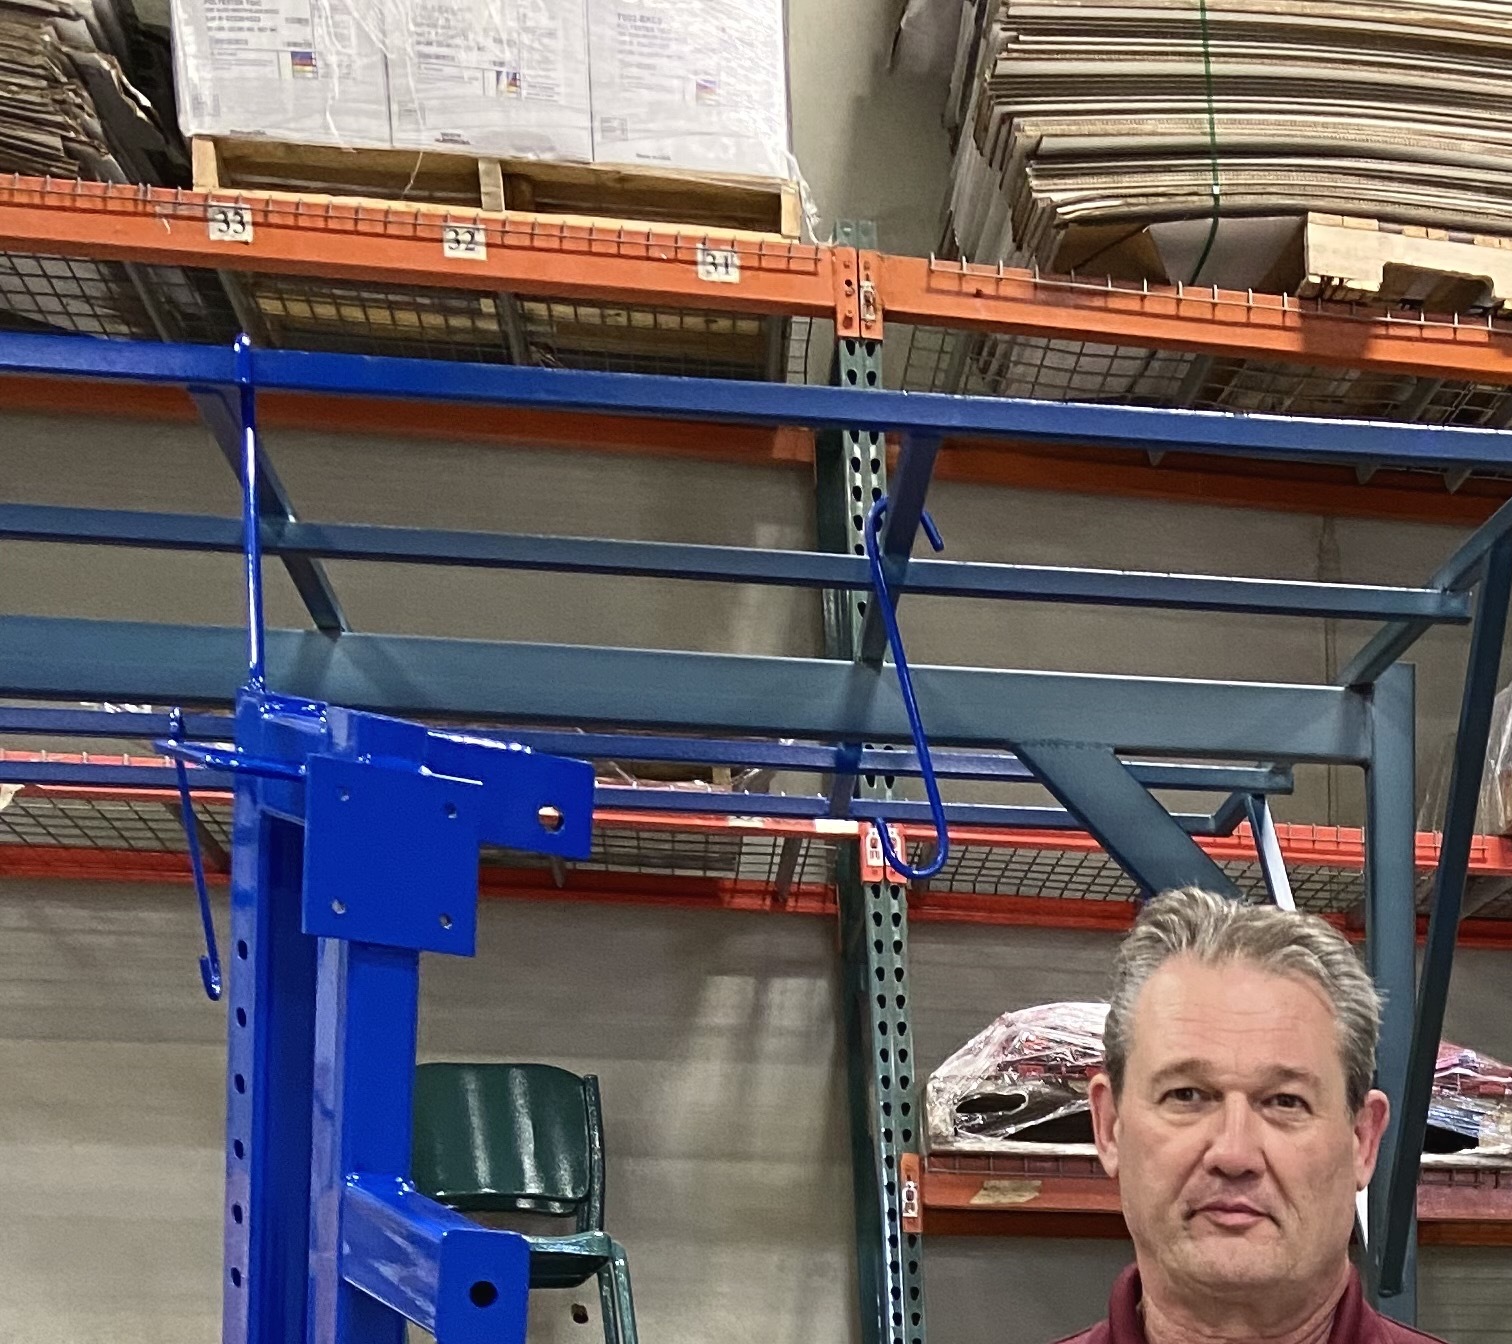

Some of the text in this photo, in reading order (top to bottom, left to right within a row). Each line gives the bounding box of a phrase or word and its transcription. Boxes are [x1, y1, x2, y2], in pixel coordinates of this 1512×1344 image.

[214, 208, 246, 234] 33
[446, 228, 475, 251] 32
[705, 252, 732, 276] 31
